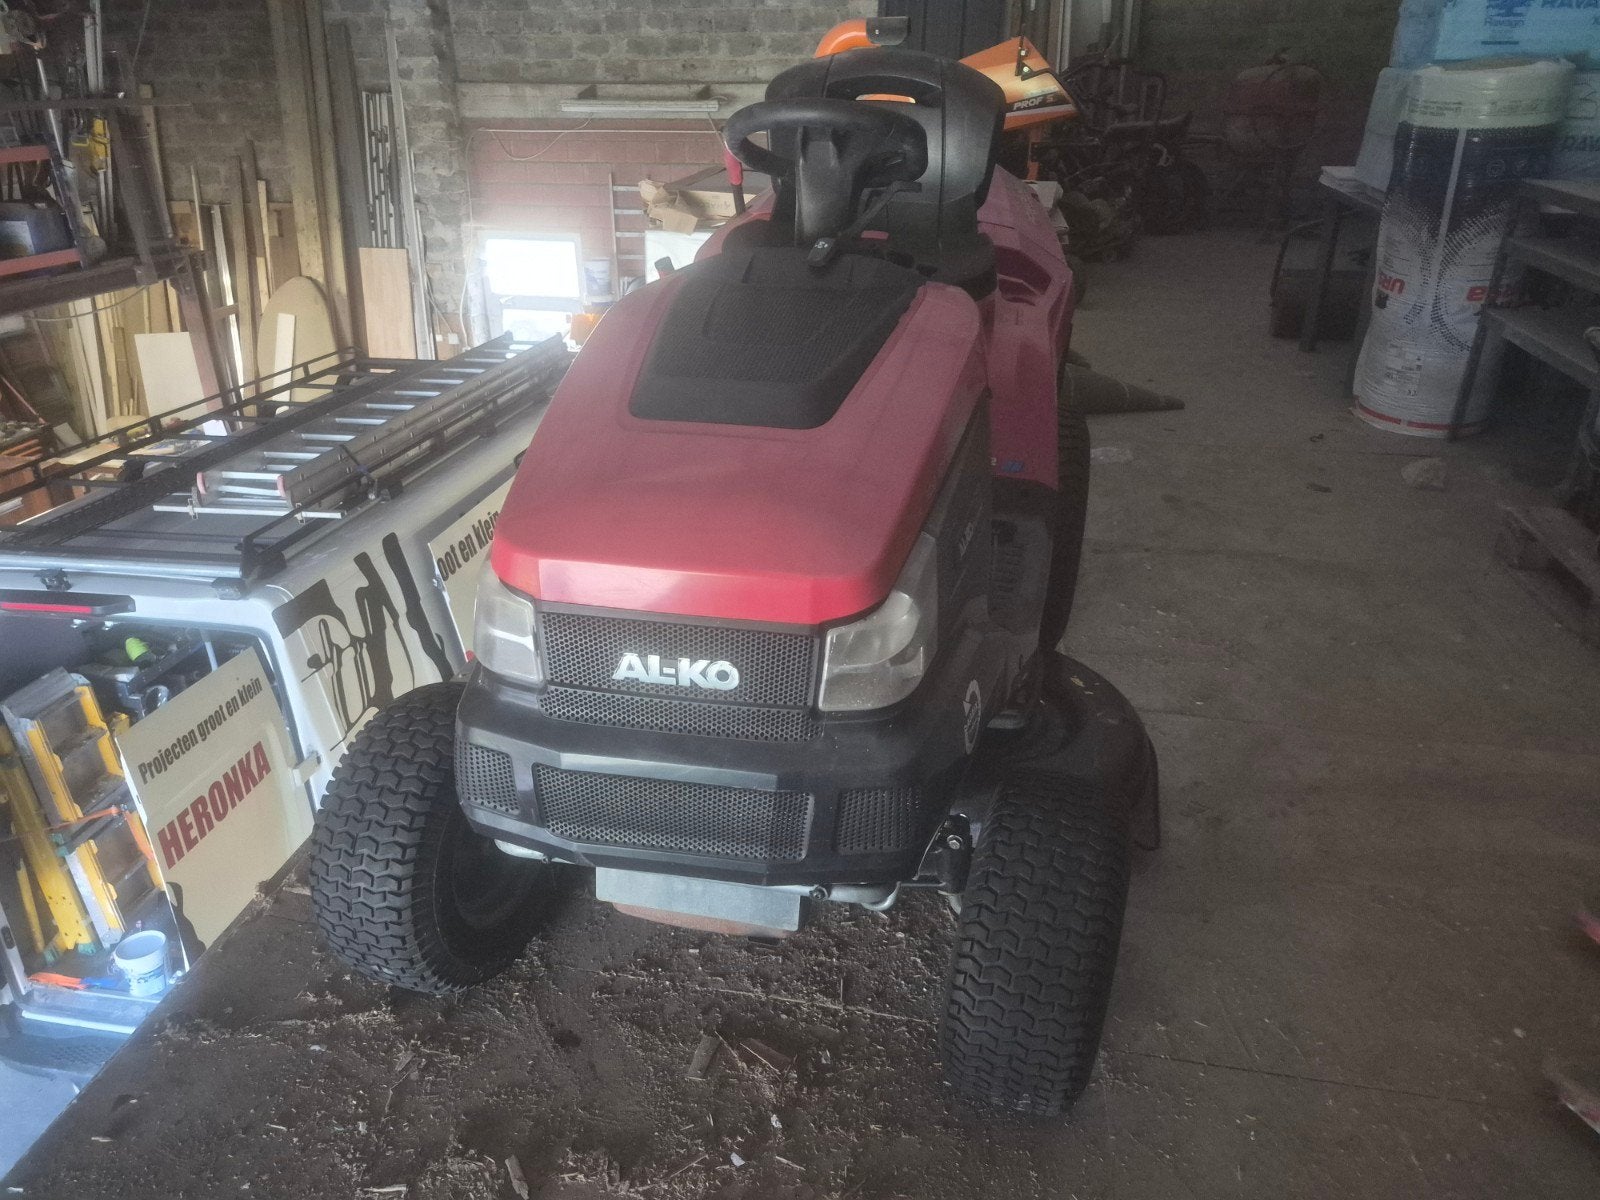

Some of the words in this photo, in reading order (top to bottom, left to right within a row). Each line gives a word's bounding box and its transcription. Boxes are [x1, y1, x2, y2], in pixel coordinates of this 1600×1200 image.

[1013, 96, 1043, 110] PROF
[459, 533, 478, 563] en
[612, 652, 740, 691] AL-KO
[138, 727, 199, 785] Projecten
[197, 704, 227, 742] groot
[225, 696, 241, 718] en
[237, 677, 263, 707] klein
[157, 740, 272, 870] HERONKA
